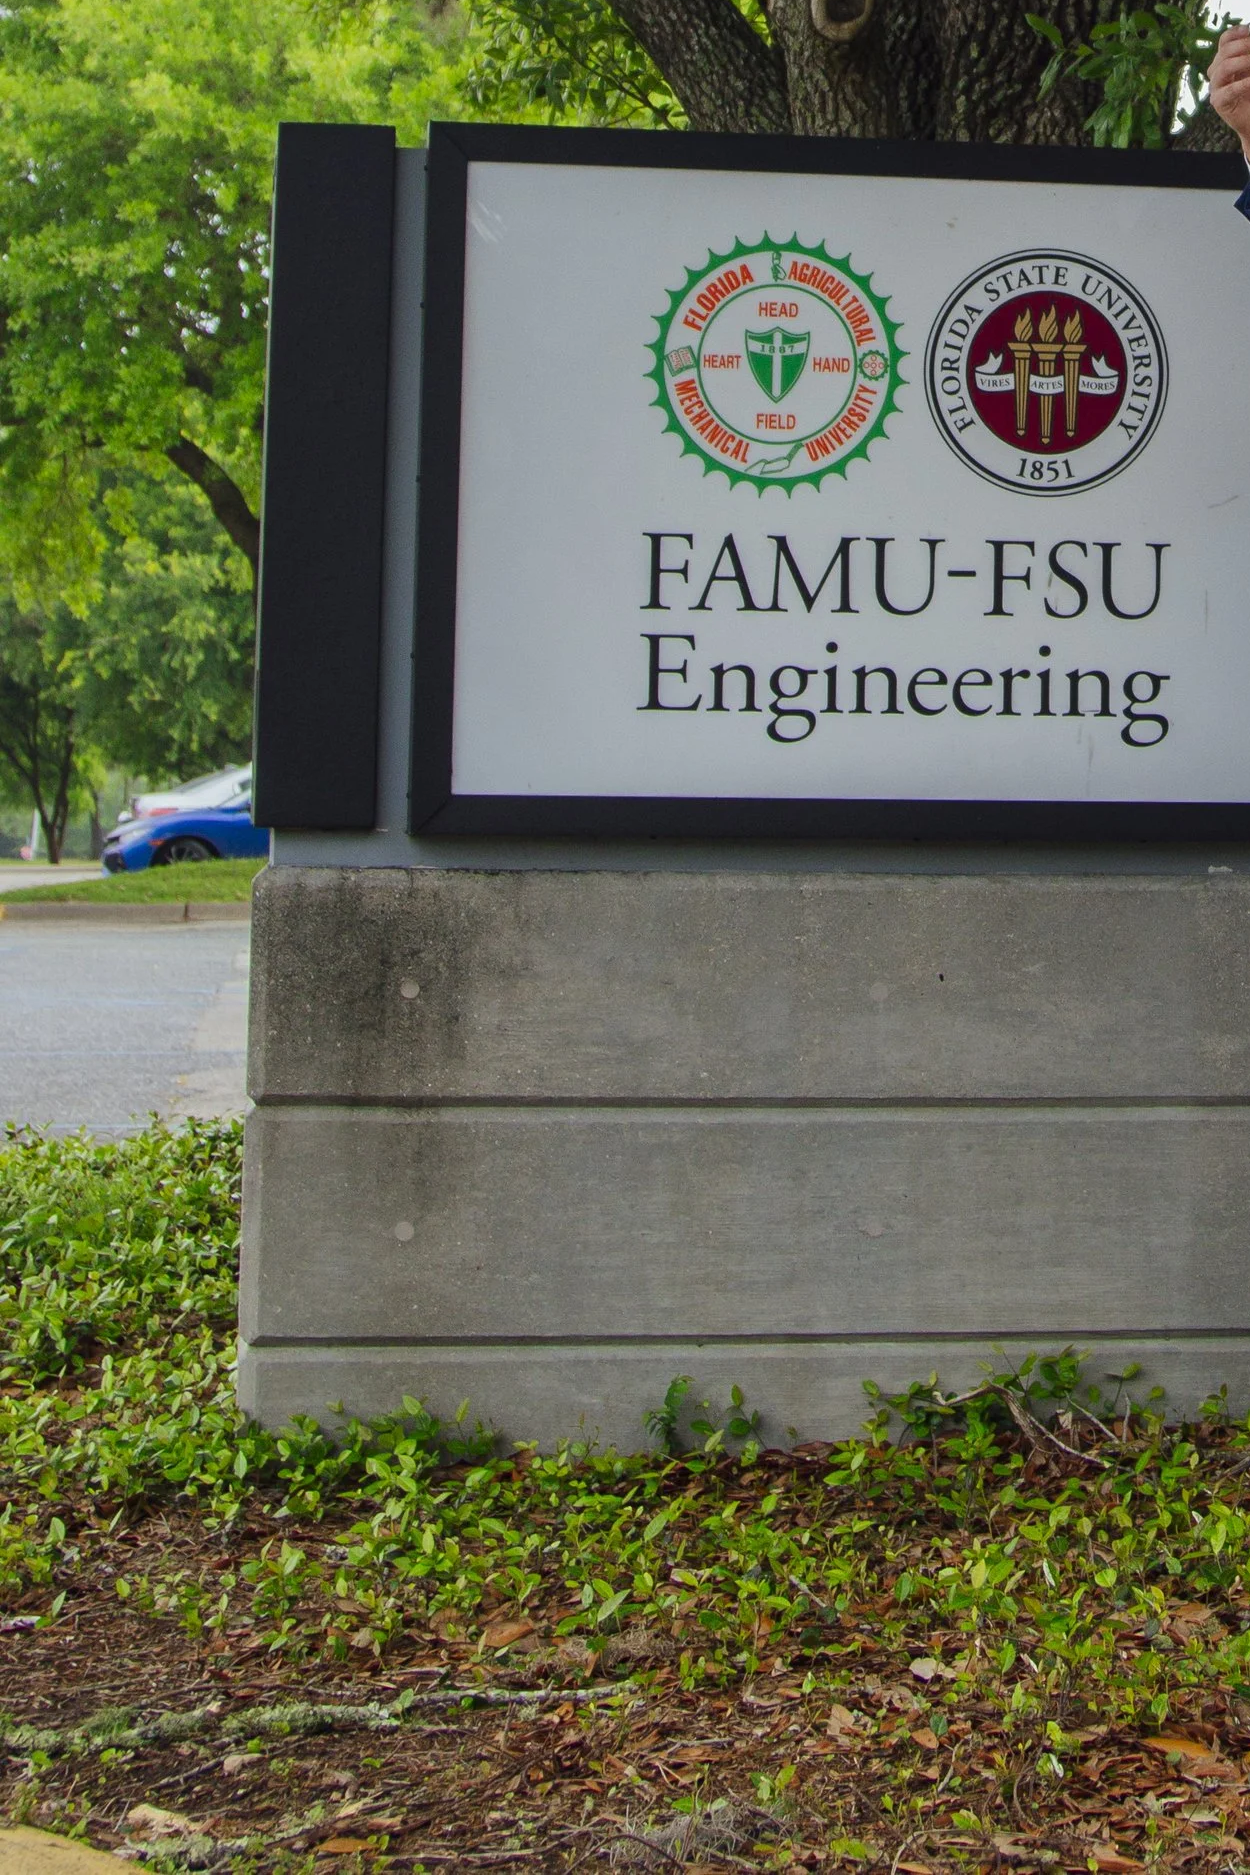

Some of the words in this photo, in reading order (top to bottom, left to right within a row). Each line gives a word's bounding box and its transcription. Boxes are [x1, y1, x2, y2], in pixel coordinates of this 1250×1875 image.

[682, 263, 755, 332] FLORIDA
[787, 260, 877, 347] AGRICULTURAL
[758, 302, 799, 318] HEAD
[703, 354, 742, 370] HEART
[812, 357, 851, 373] HAND
[941, 303, 984, 434] FLORIDA
[983, 265, 1069, 302] STATE
[1080, 273, 1153, 440] UNIVERSITY
[979, 377, 1011, 388] VIRES
[1030, 379, 1063, 391] ARTES
[1080, 380, 1116, 391] MORES
[674, 378, 750, 463] MECHANICAL
[804, 384, 878, 462] UNIVERSITY
[756, 413, 796, 430] FIELD
[1016, 457, 1076, 483] 1851
[639, 532, 1171, 620] FAMU-FSU
[636, 633, 1171, 748] Engineering
